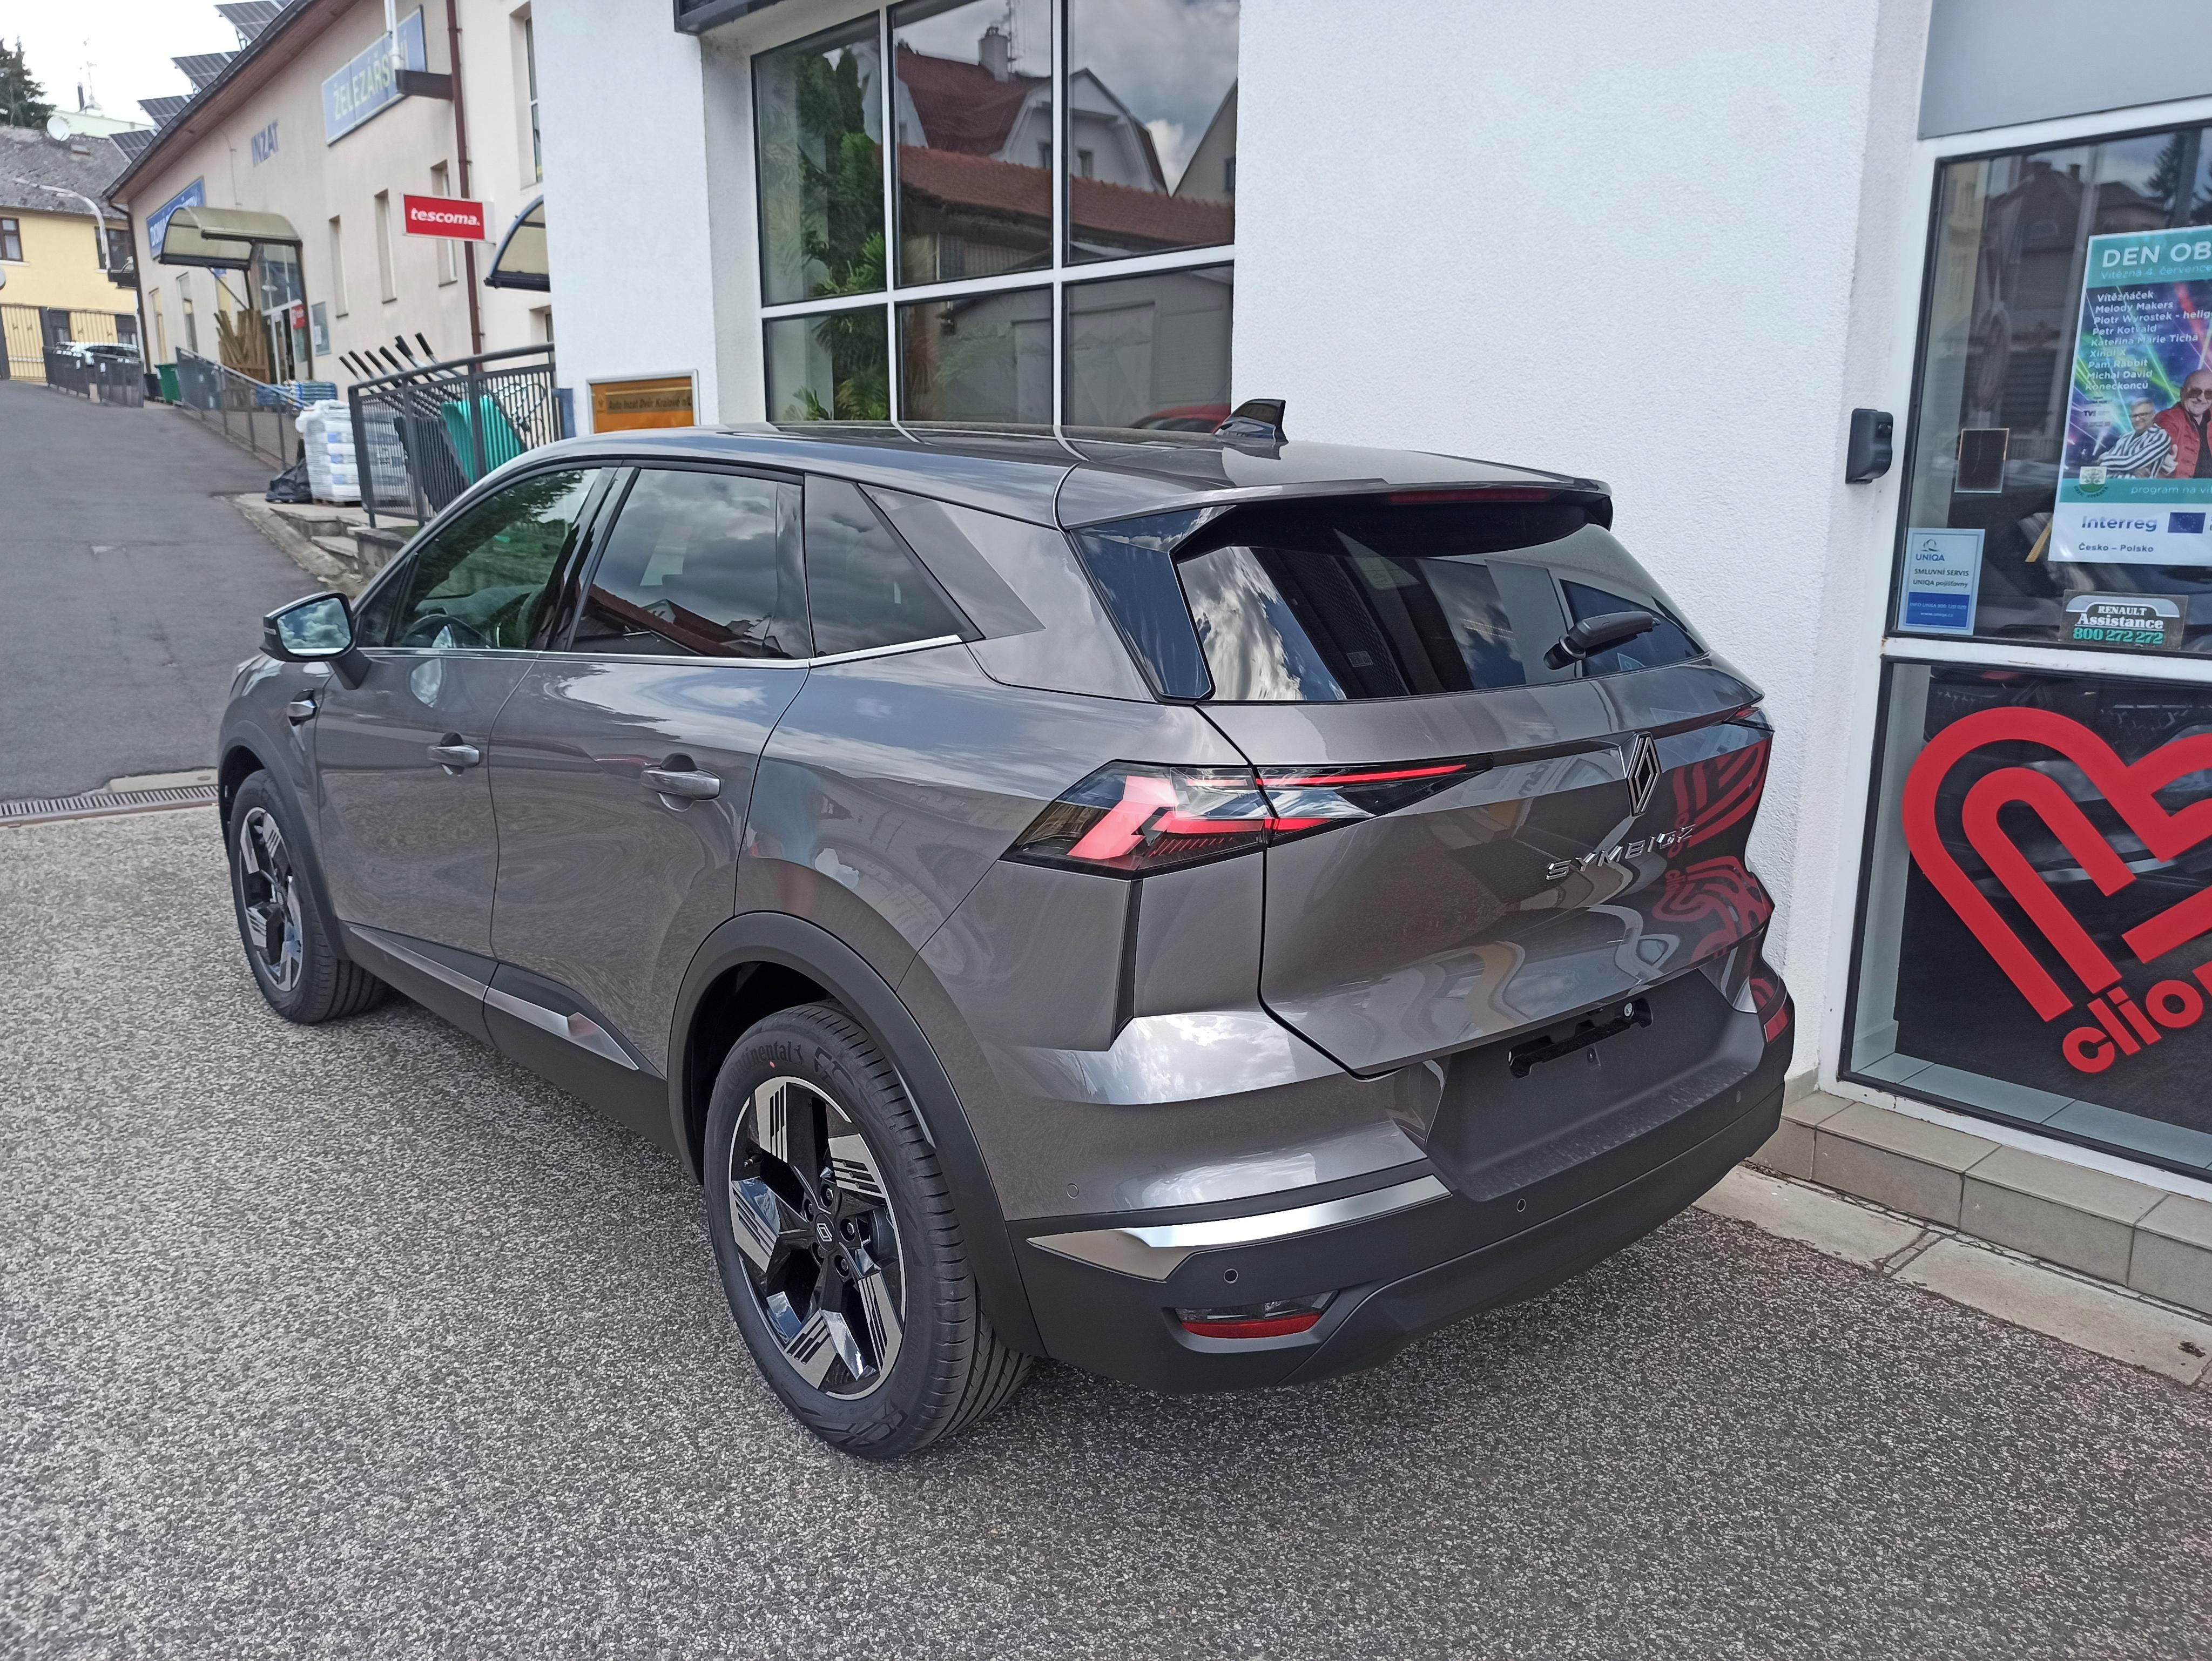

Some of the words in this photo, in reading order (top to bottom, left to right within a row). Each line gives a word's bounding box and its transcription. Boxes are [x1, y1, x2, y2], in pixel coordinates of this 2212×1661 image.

[333, 30, 409, 121] ŽELEZÁŘSÍ
[251, 119, 279, 167] INZAT
[2102, 245, 2160, 268] DEN
[2095, 304, 2133, 313] Melody
[2136, 301, 2174, 311] Makers
[2094, 316, 2119, 325] Piotr
[2122, 312, 2172, 323] Wyrostek
[2183, 310, 2212, 320] helig
[2092, 327, 2114, 336] Petr
[2117, 324, 2157, 334] Kotvald
[2090, 337, 2134, 347] Kateřina
[2137, 335, 2166, 344] Marie
[2114, 359, 2148, 368] Rabbit
[2087, 370, 2120, 379] Michal
[2123, 369, 2153, 378] David
[2082, 516, 2157, 532] Interreg
[2079, 542, 2109, 551] Česko
[1914, 568, 1945, 576] SMLUVNÍ
[2098, 605, 2147, 616] RENAULT
[2076, 613, 2164, 629] Assistance
[2073, 627, 2103, 640] 800
[2106, 630, 2133, 642] 272
[2135, 631, 2163, 644] 272
[1546, 823, 1696, 881] SYMBIOZ
[2062, 980, 2203, 1073] clio
